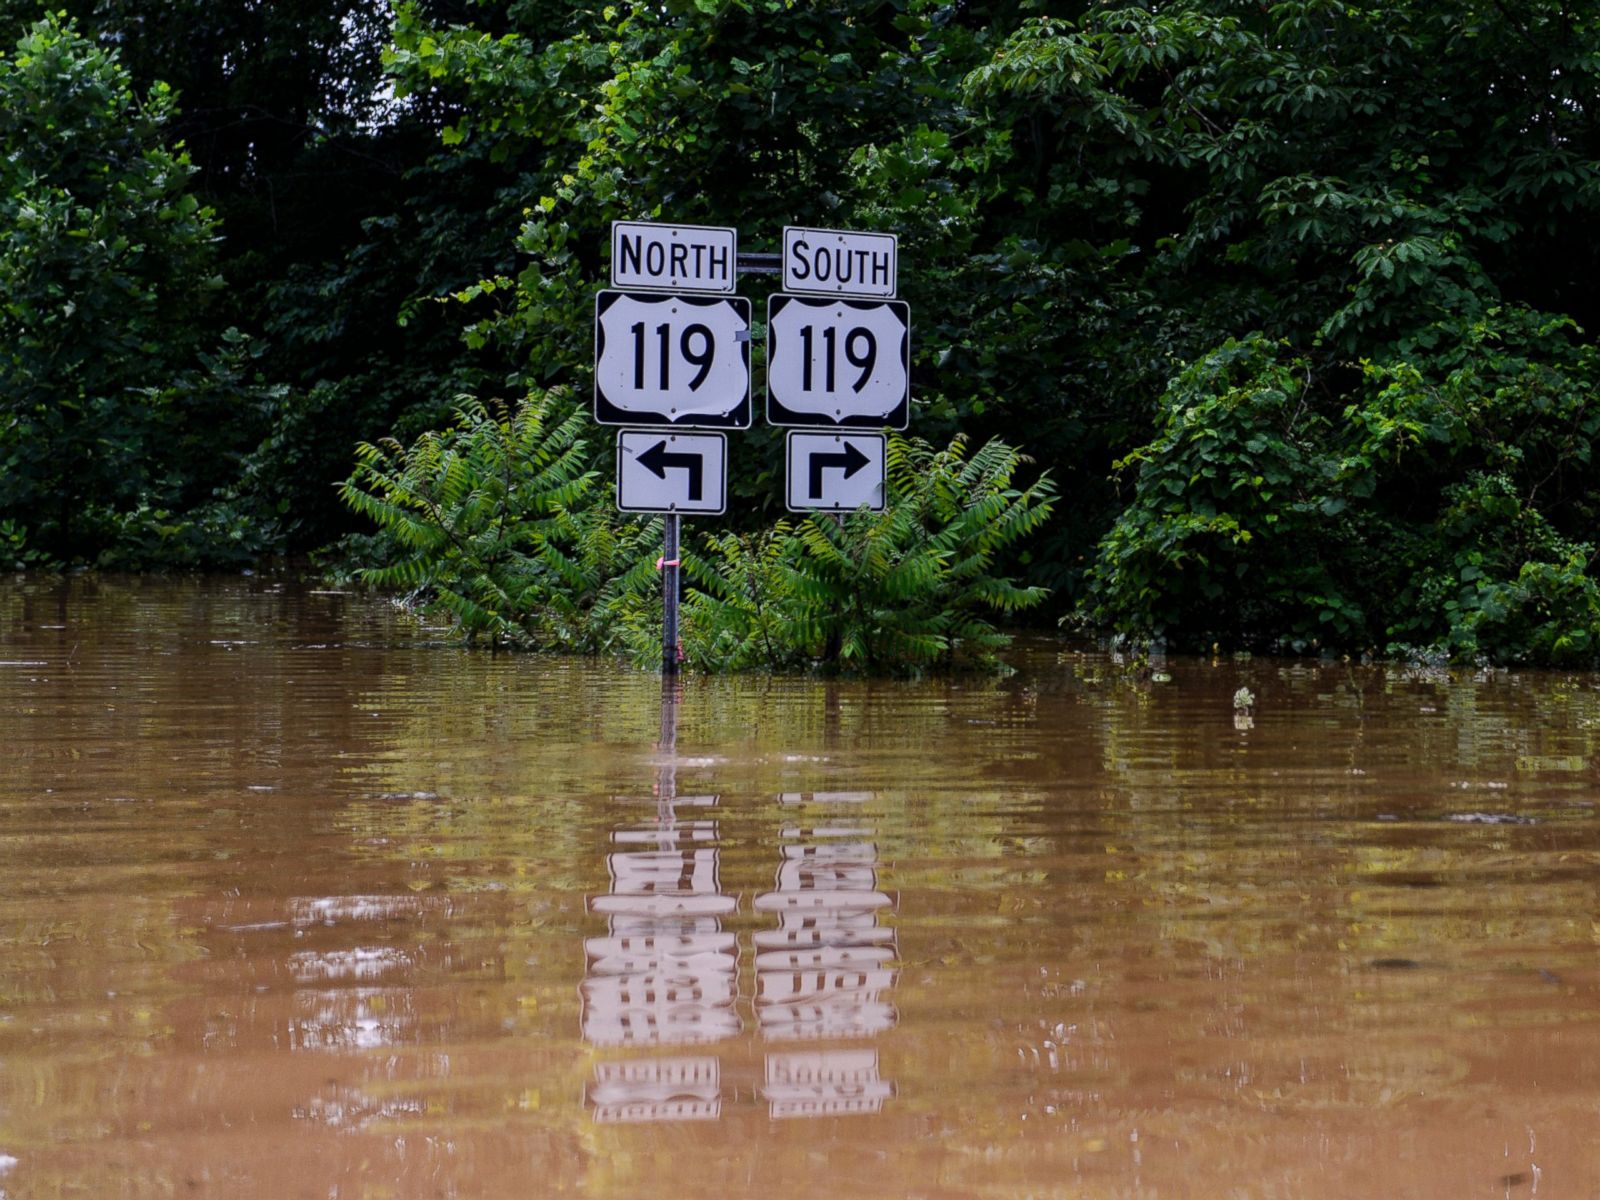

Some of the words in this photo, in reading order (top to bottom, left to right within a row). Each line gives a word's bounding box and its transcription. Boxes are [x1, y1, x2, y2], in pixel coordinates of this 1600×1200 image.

[620, 234, 728, 281] NORTH
[791, 240, 889, 285] SOUTH
[631, 322, 715, 392] 119
[800, 325, 877, 394] 119
